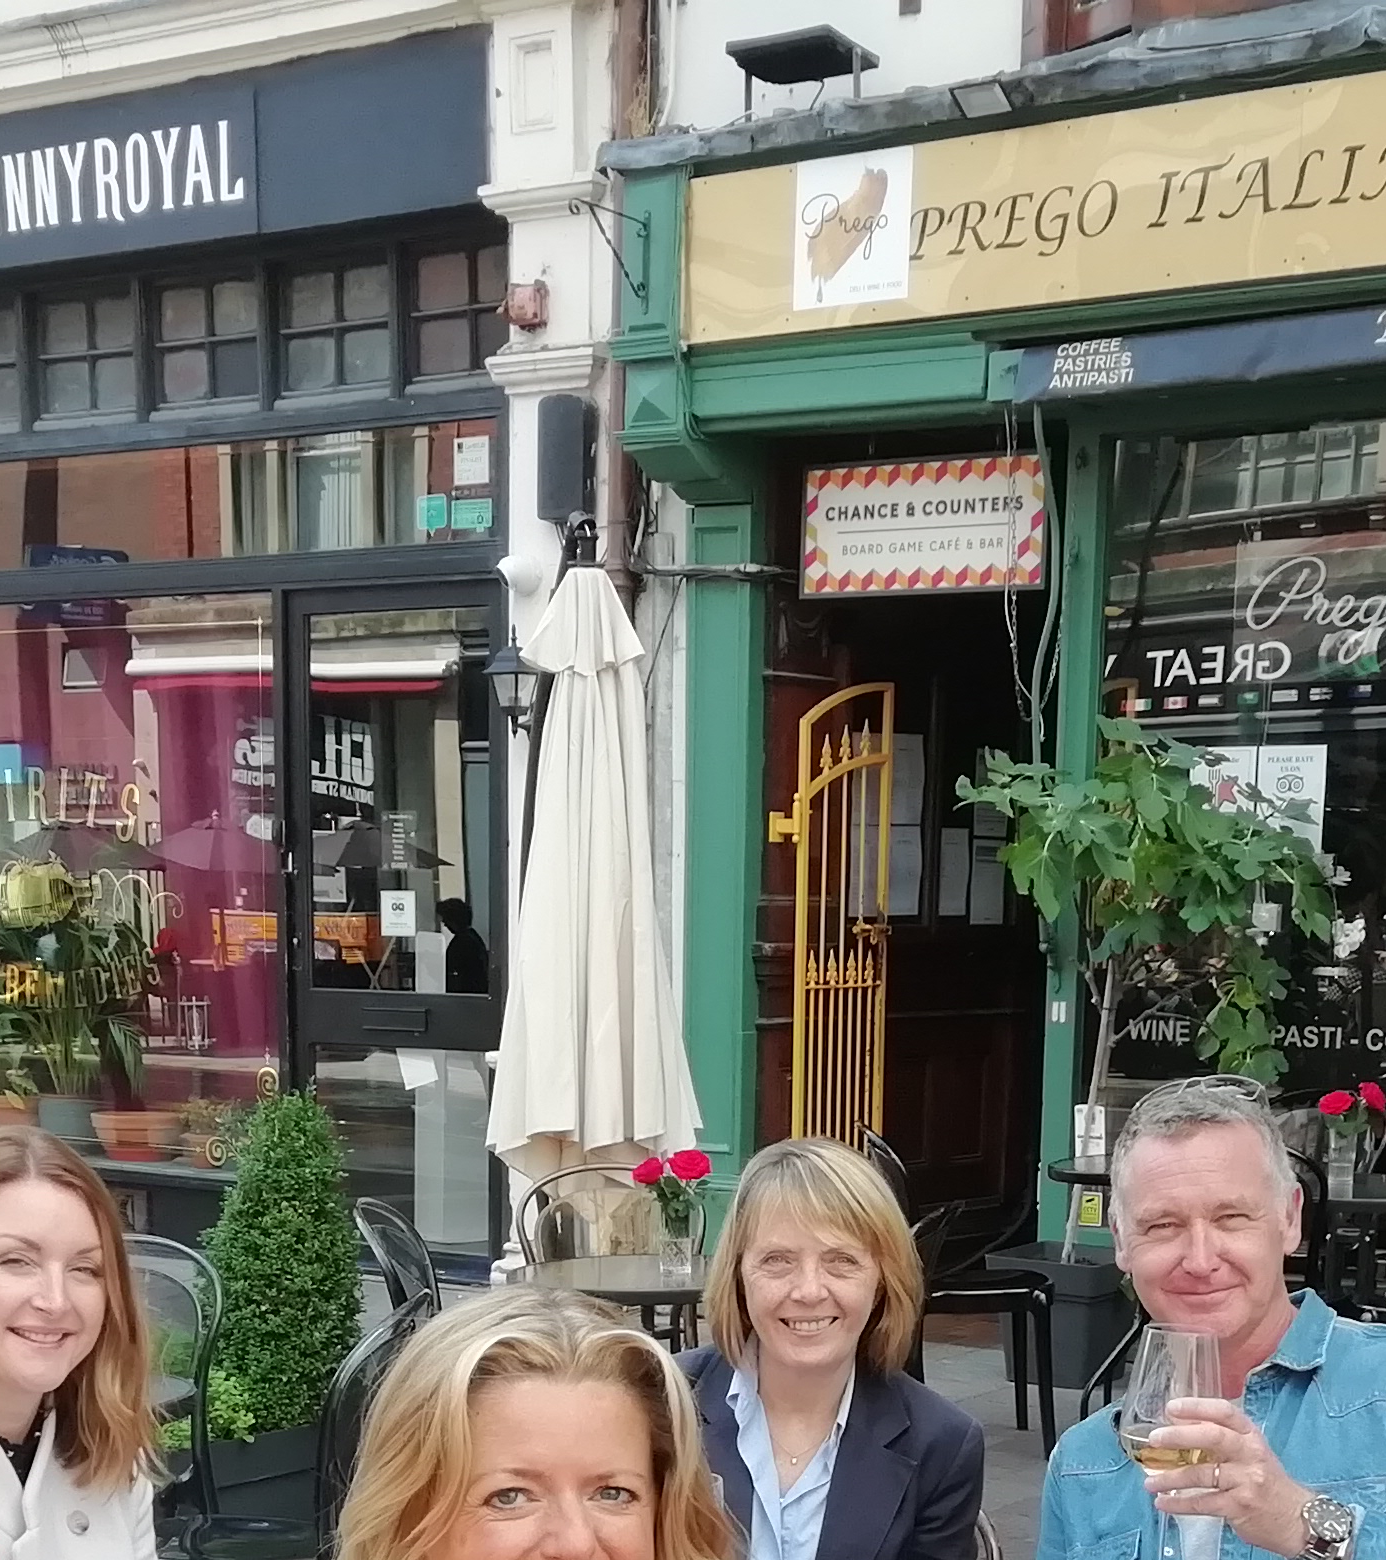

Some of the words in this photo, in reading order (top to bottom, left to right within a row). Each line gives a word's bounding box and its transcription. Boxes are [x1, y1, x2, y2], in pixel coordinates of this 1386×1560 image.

[801, 193, 889, 260] Prego
[909, 179, 1119, 261] PREGO
[1057, 337, 1123, 357] COFFEE
[1053, 351, 1132, 373] PASTRIES
[1048, 368, 1134, 389] ANTIPASTI
[825, 503, 899, 521] CHANCE
[906, 502, 915, 517] &
[922, 495, 1024, 516] COUNTERS
[842, 542, 883, 556] BOARD
[888, 541, 924, 553] GAME
[929, 537, 960, 551] CAFÉ
[966, 538, 973, 549] &
[979, 537, 1004, 549] BAR
[391, 903, 405, 911] GQ
[1129, 1018, 1190, 1042] WINE
[1270, 1025, 1342, 1049] PASTI
